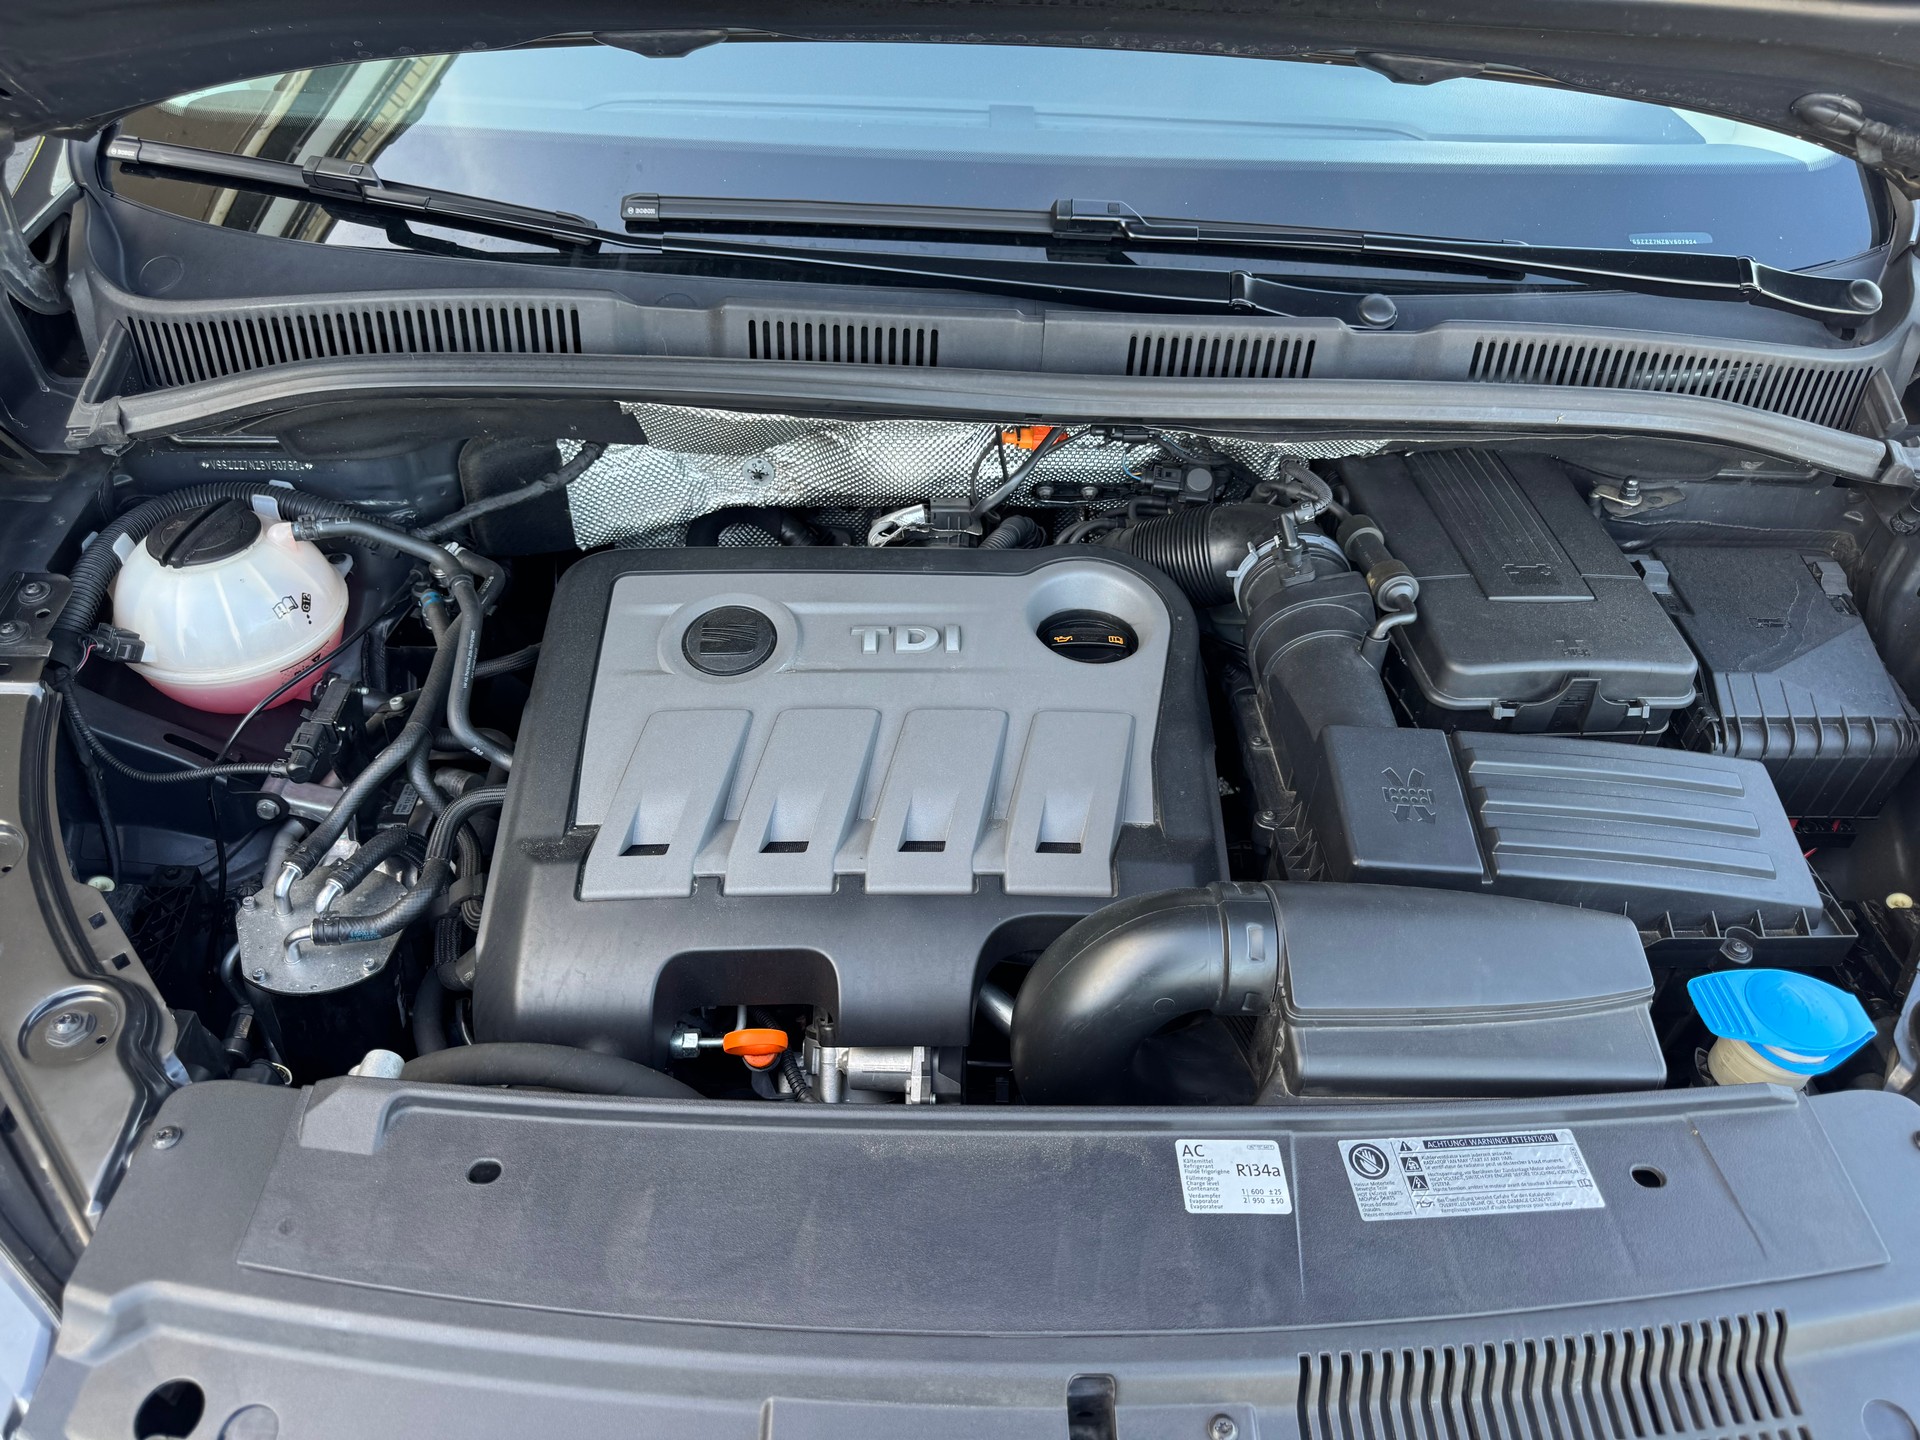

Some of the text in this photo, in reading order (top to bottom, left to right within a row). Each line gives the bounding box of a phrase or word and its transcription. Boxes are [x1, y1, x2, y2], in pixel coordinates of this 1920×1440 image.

[850, 624, 962, 654] TDI
[1427, 1136, 1554, 1148] ACHTUNG! WARNING! ATTENTION!
[1182, 1145, 1204, 1157] AC
[1237, 1164, 1280, 1177] R134a
